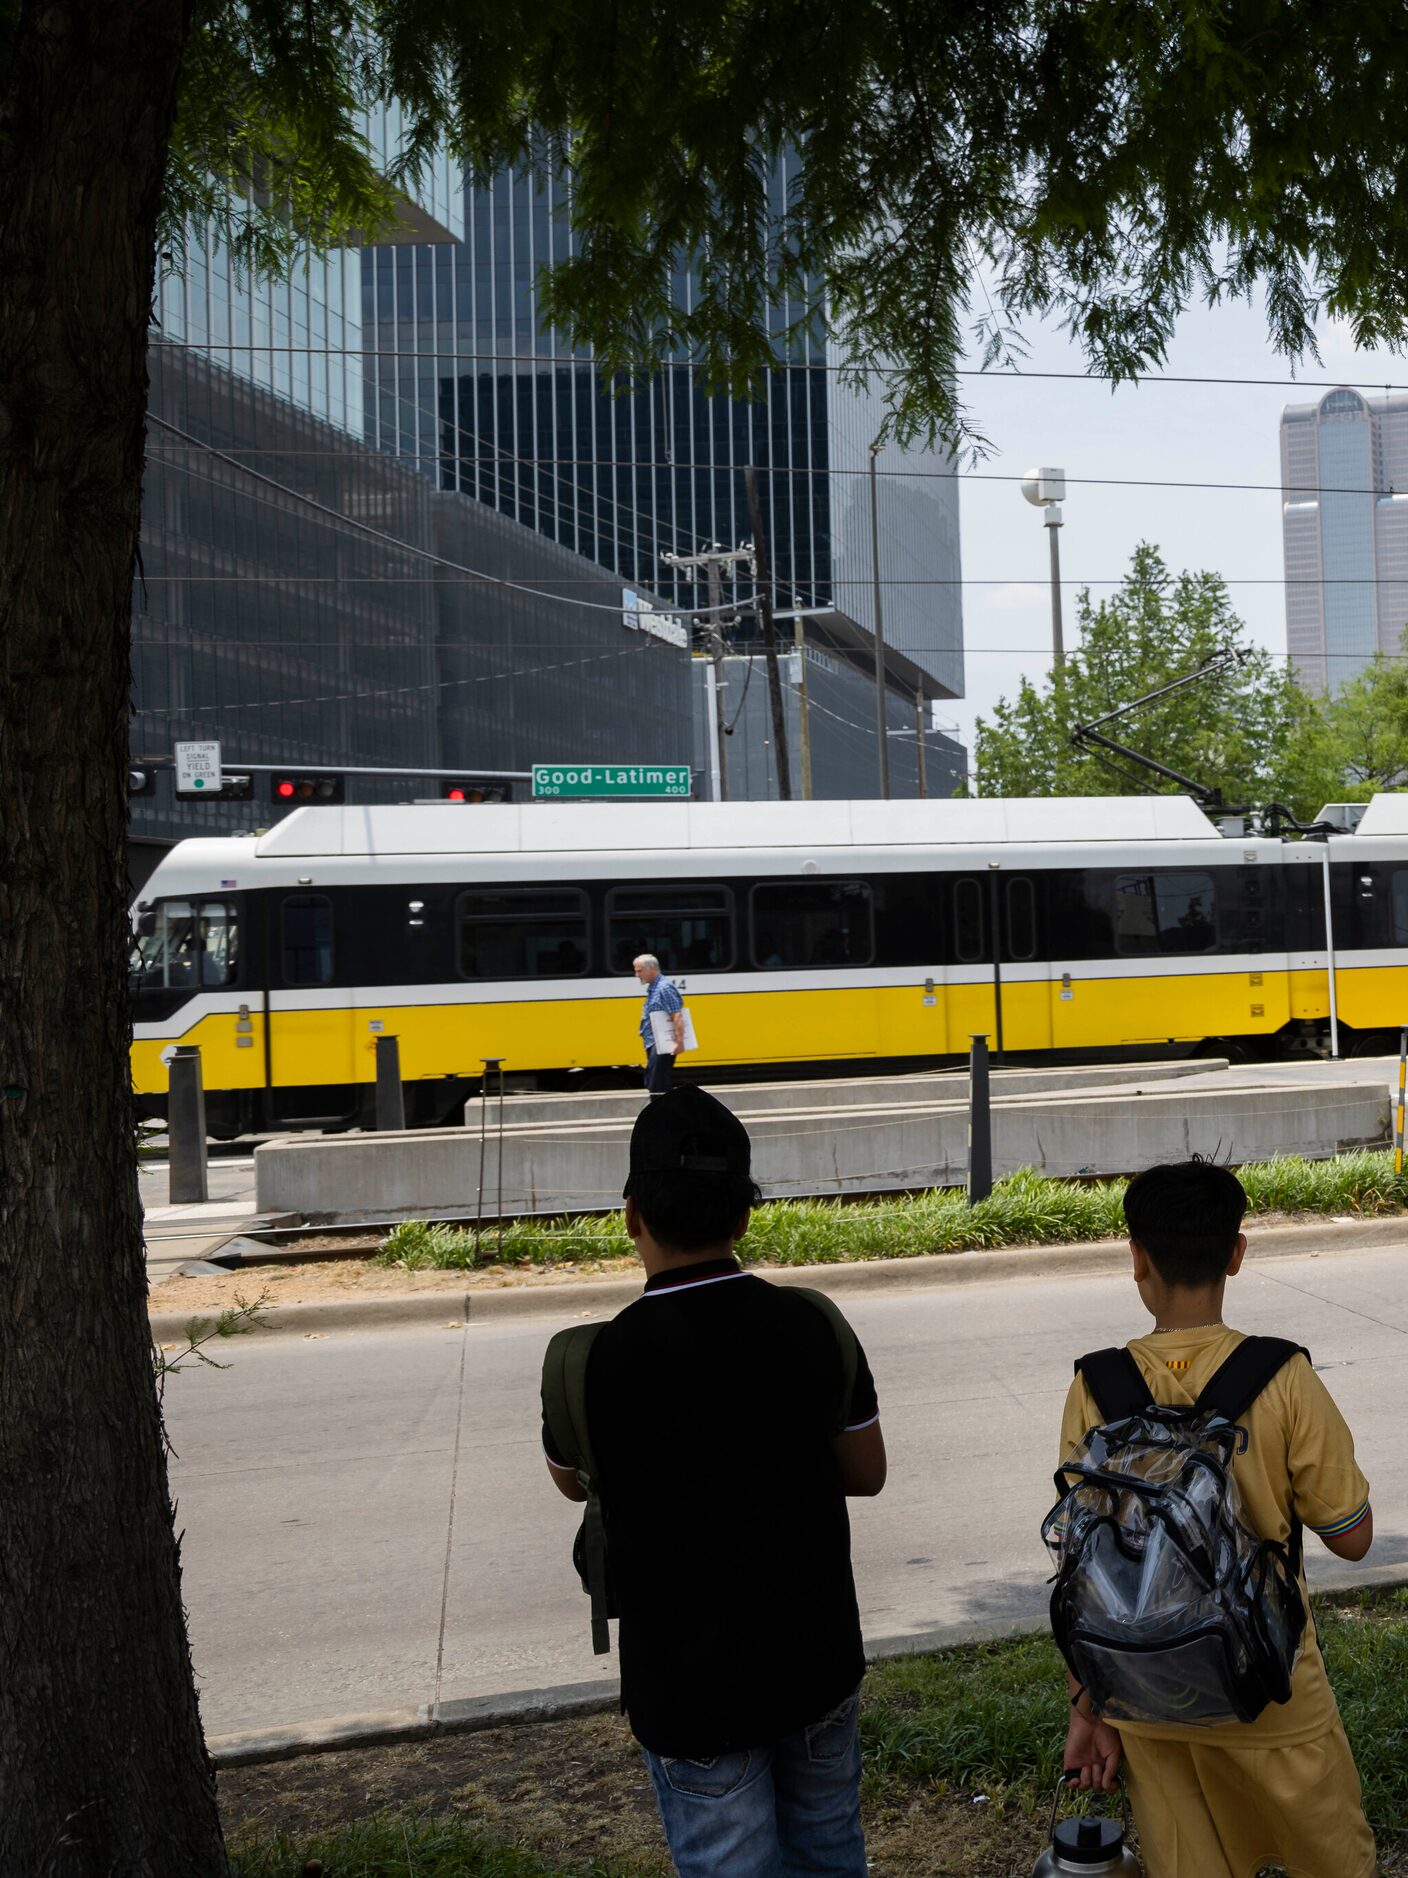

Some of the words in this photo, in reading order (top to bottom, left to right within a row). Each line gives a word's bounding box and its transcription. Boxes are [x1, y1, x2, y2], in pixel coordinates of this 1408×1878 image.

[187, 762, 210, 771] YIELD
[536, 768, 687, 785] Good-Latimer
[538, 786, 560, 795] 300
[664, 785, 687, 794] 400
